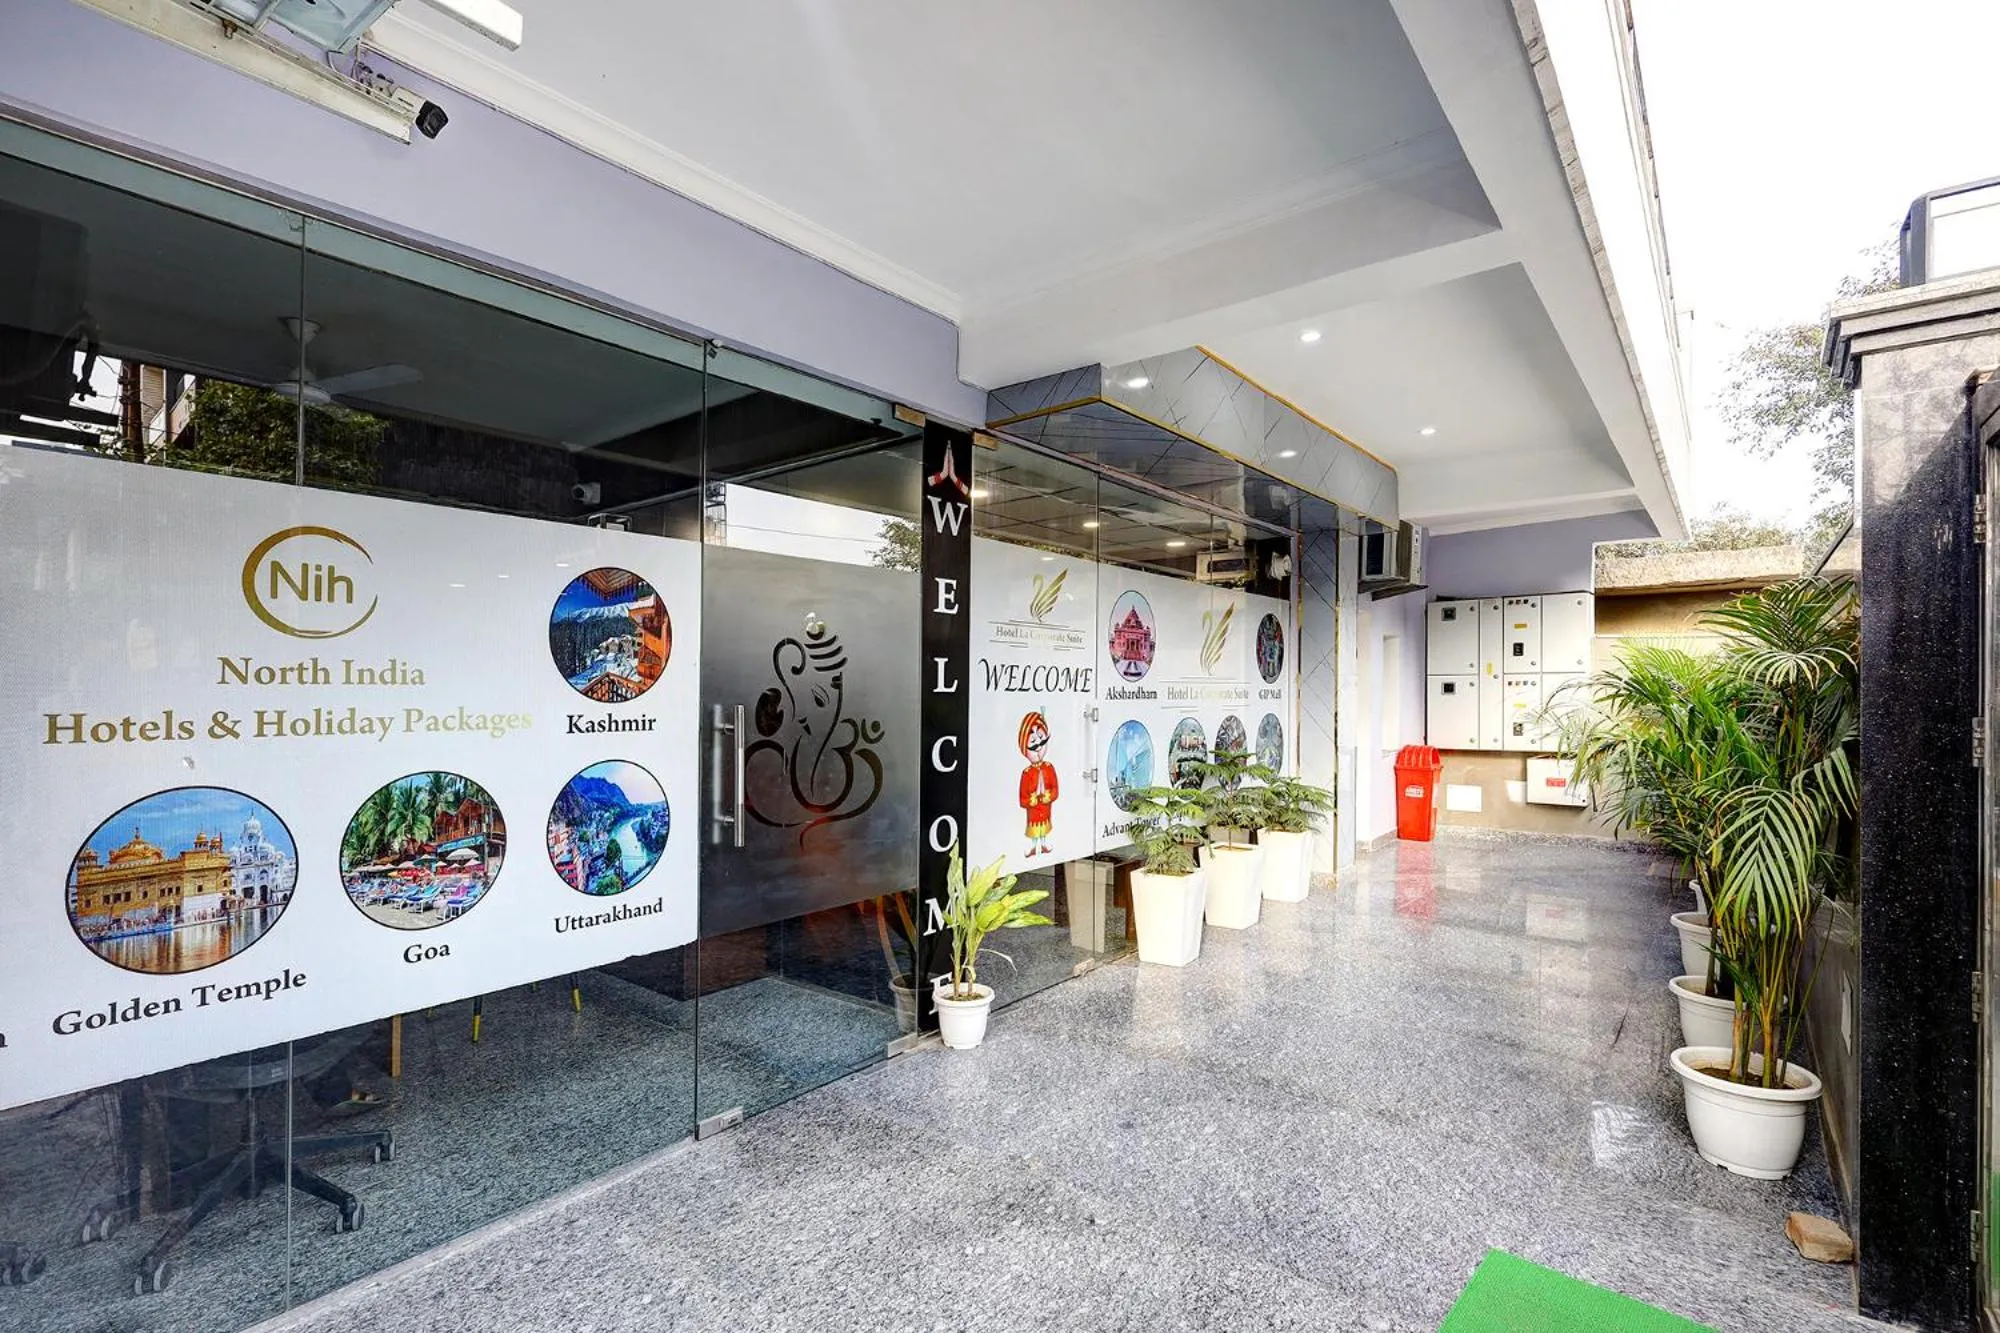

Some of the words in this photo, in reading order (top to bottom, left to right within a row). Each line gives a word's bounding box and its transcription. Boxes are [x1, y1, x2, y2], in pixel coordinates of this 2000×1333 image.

[269, 560, 354, 604] Nih
[996, 625, 1018, 638] Hotel
[1020, 629, 1028, 639] La
[1030, 630, 1065, 643] Corate
[216, 656, 332, 686] North
[341, 659, 426, 686] India
[978, 657, 1093, 693] WELCOME
[1105, 685, 1157, 700] Akshardham
[1167, 686, 1189, 700] Hotel
[42, 710, 195, 745] Hotels
[207, 710, 240, 739] &
[252, 706, 393, 744] Holiday
[402, 705, 533, 736] Packages
[566, 713, 657, 735] Kashmir
[554, 897, 664, 933] Uttarakhand
[402, 941, 451, 965] Goa
[52, 997, 183, 1036] Golden
[191, 968, 307, 1008] Temple
